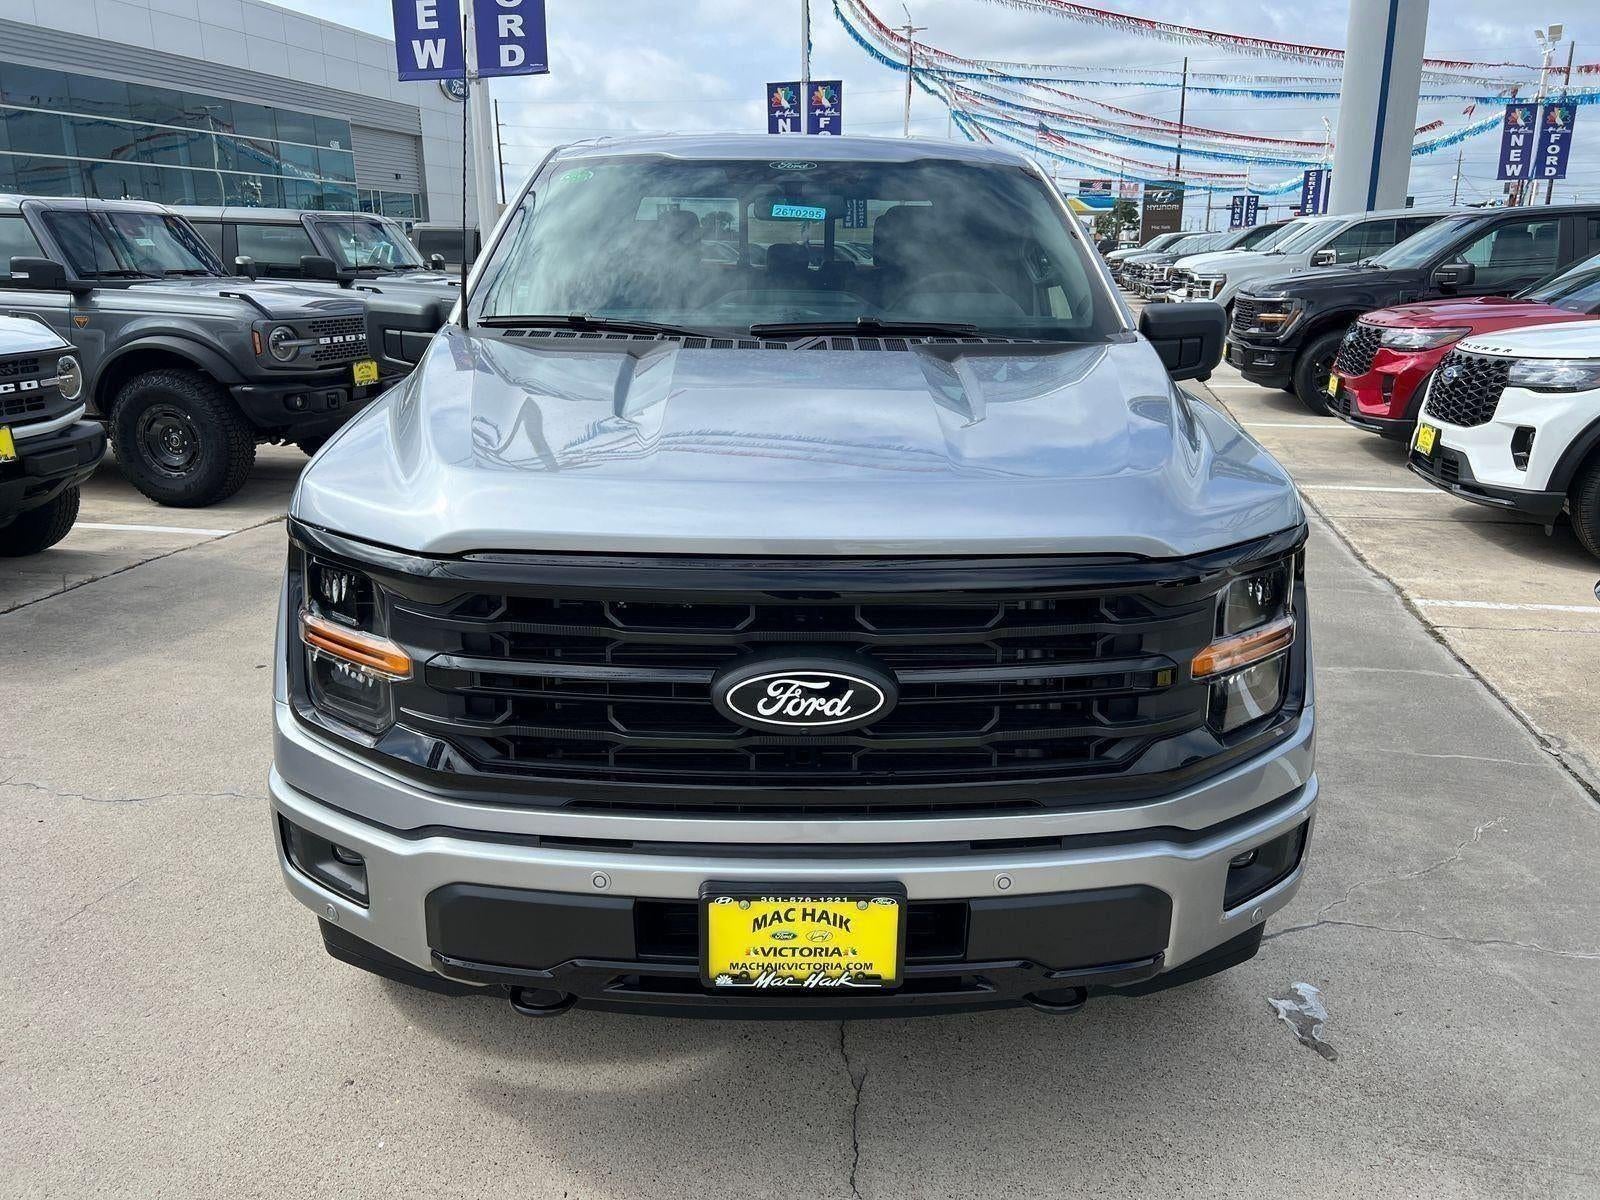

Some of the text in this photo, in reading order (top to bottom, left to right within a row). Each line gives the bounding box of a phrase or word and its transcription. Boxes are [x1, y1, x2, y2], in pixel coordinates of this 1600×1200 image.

[1505, 134, 1524, 177] NEW
[1544, 133, 1561, 177] FORD
[775, 207, 823, 219] 26T0295
[1232, 207, 1240, 226] NEW
[756, 679, 854, 717] Ford
[752, 907, 851, 933] MAC HAIK
[760, 946, 843, 957] VICTORIA
[729, 962, 873, 971] MACHAIKVICTORIA.COM
[752, 971, 853, 988] Mac Haik
